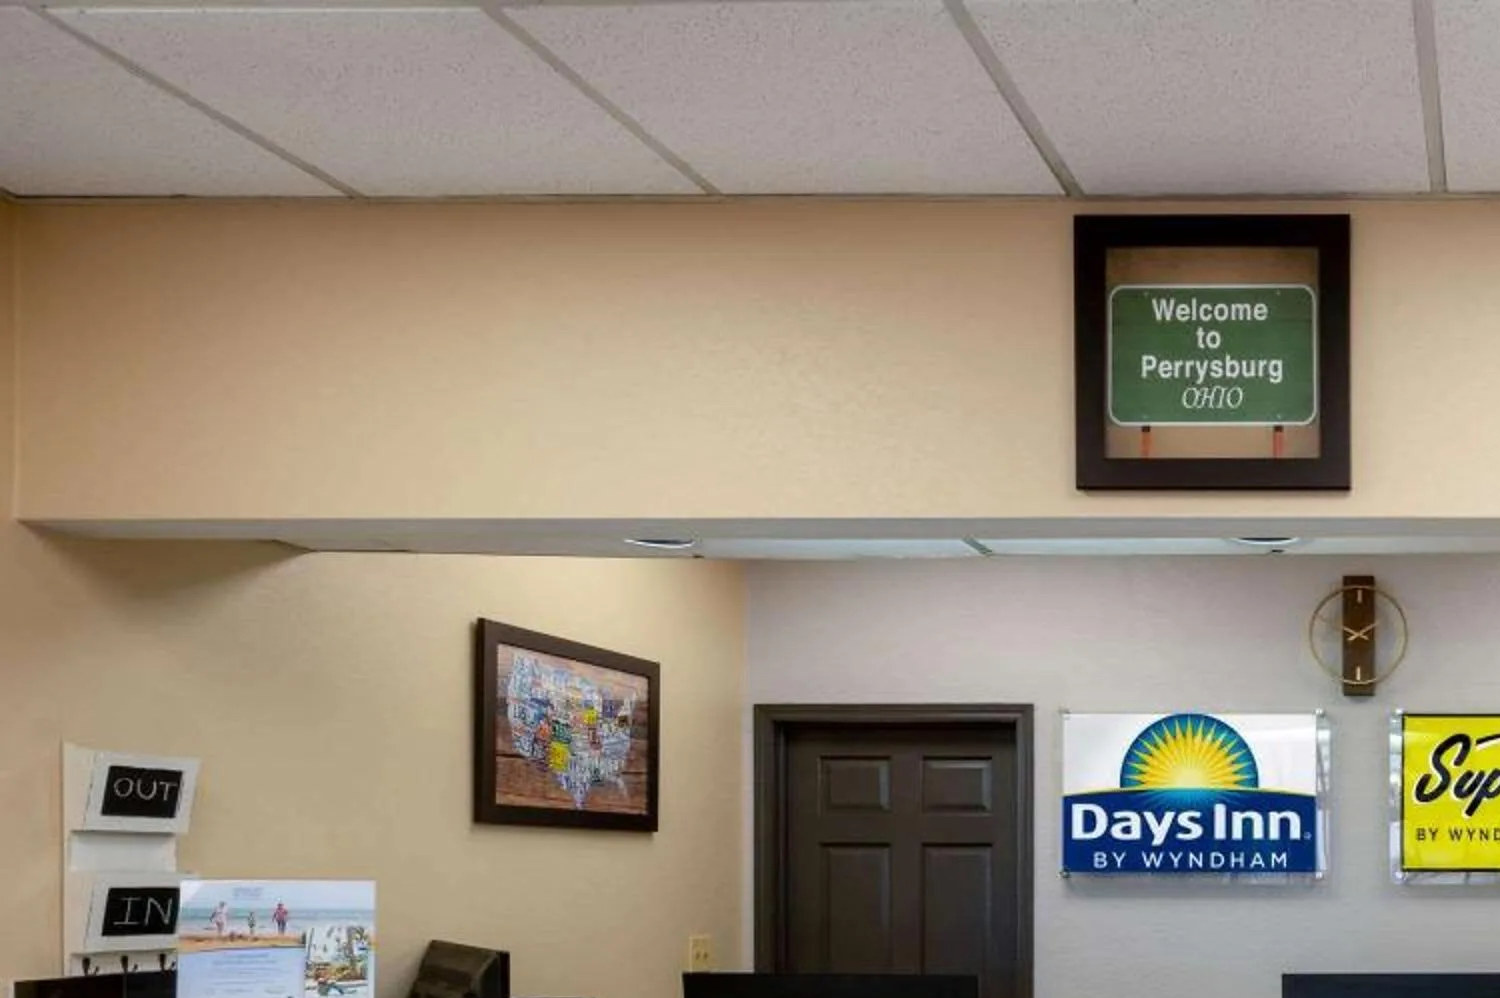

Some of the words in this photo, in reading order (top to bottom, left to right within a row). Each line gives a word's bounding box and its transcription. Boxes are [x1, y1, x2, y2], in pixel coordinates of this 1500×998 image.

[1151, 297, 1269, 322] Welcome
[1196, 326, 1221, 349] to
[1140, 354, 1283, 384] Perrysburg
[1181, 386, 1244, 409] OHIO
[112, 777, 178, 801] OUT
[1071, 803, 1203, 846] Days
[1213, 803, 1301, 840] Inn
[1416, 828, 1439, 841] BY
[1093, 852, 1127, 868] BY
[1141, 852, 1288, 868] WYNDHAM
[113, 896, 173, 926] IN
